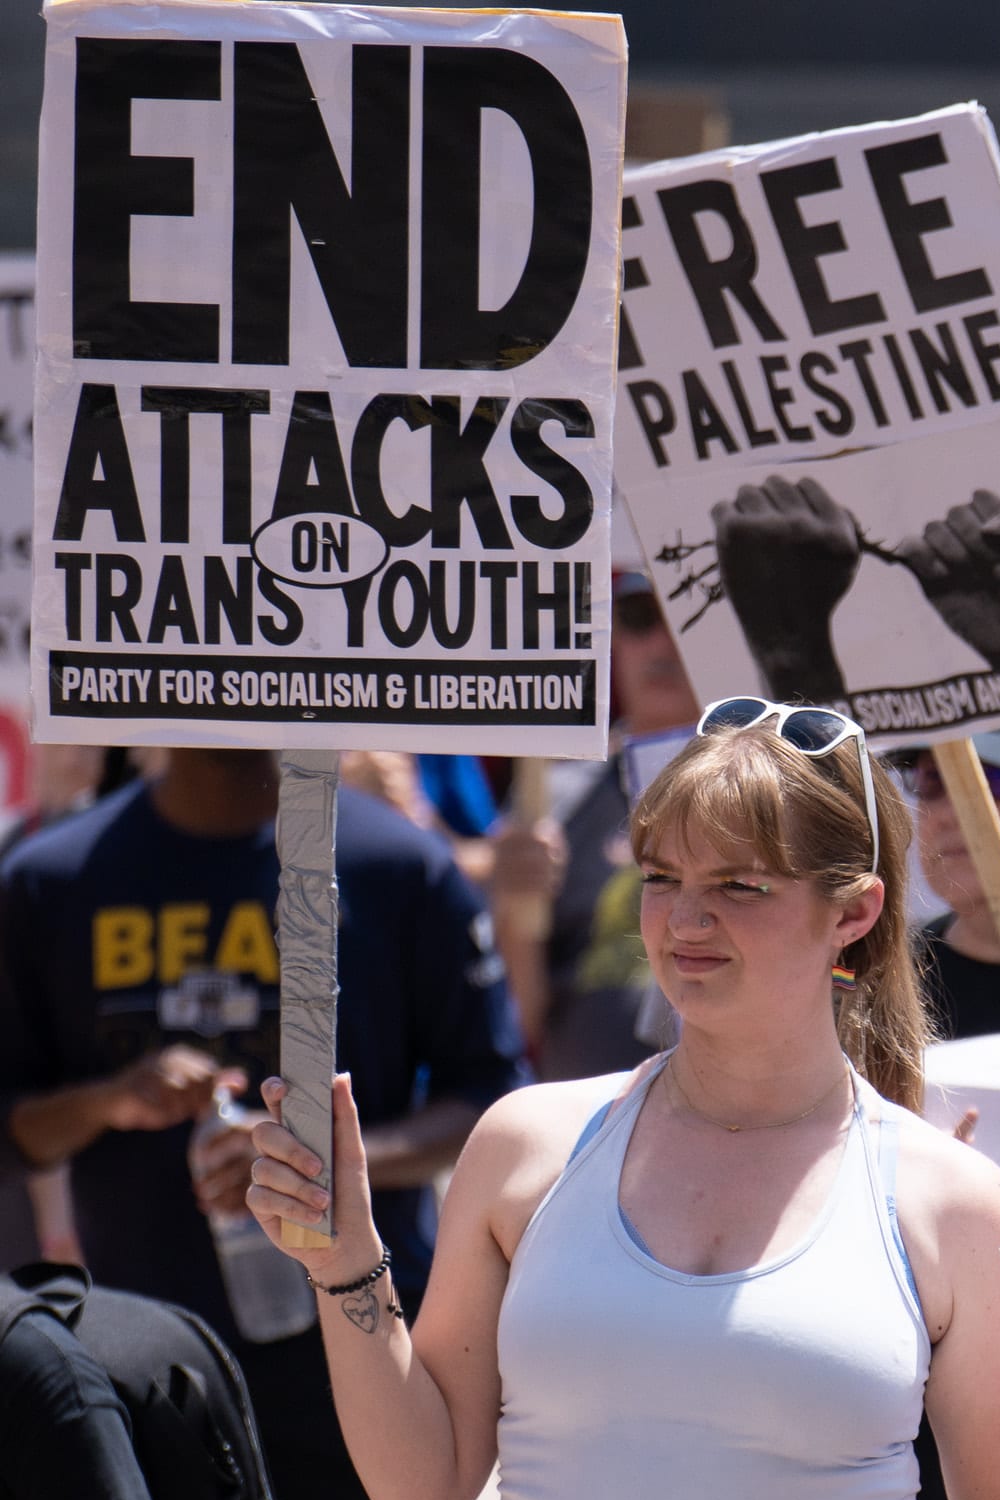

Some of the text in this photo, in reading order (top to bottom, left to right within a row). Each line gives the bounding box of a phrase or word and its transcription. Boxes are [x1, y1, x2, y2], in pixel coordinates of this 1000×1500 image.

[73, 36, 593, 371] END
[52, 383, 596, 550] ATTACKS
[291, 520, 350, 574] ON
[55, 552, 304, 647] TRANS
[340, 560, 593, 651] YOUTH!
[61, 666, 583, 711] PARTY FOR SOCIALISM & LIBERATION
[853, 675, 976, 732] SOCIALISM
